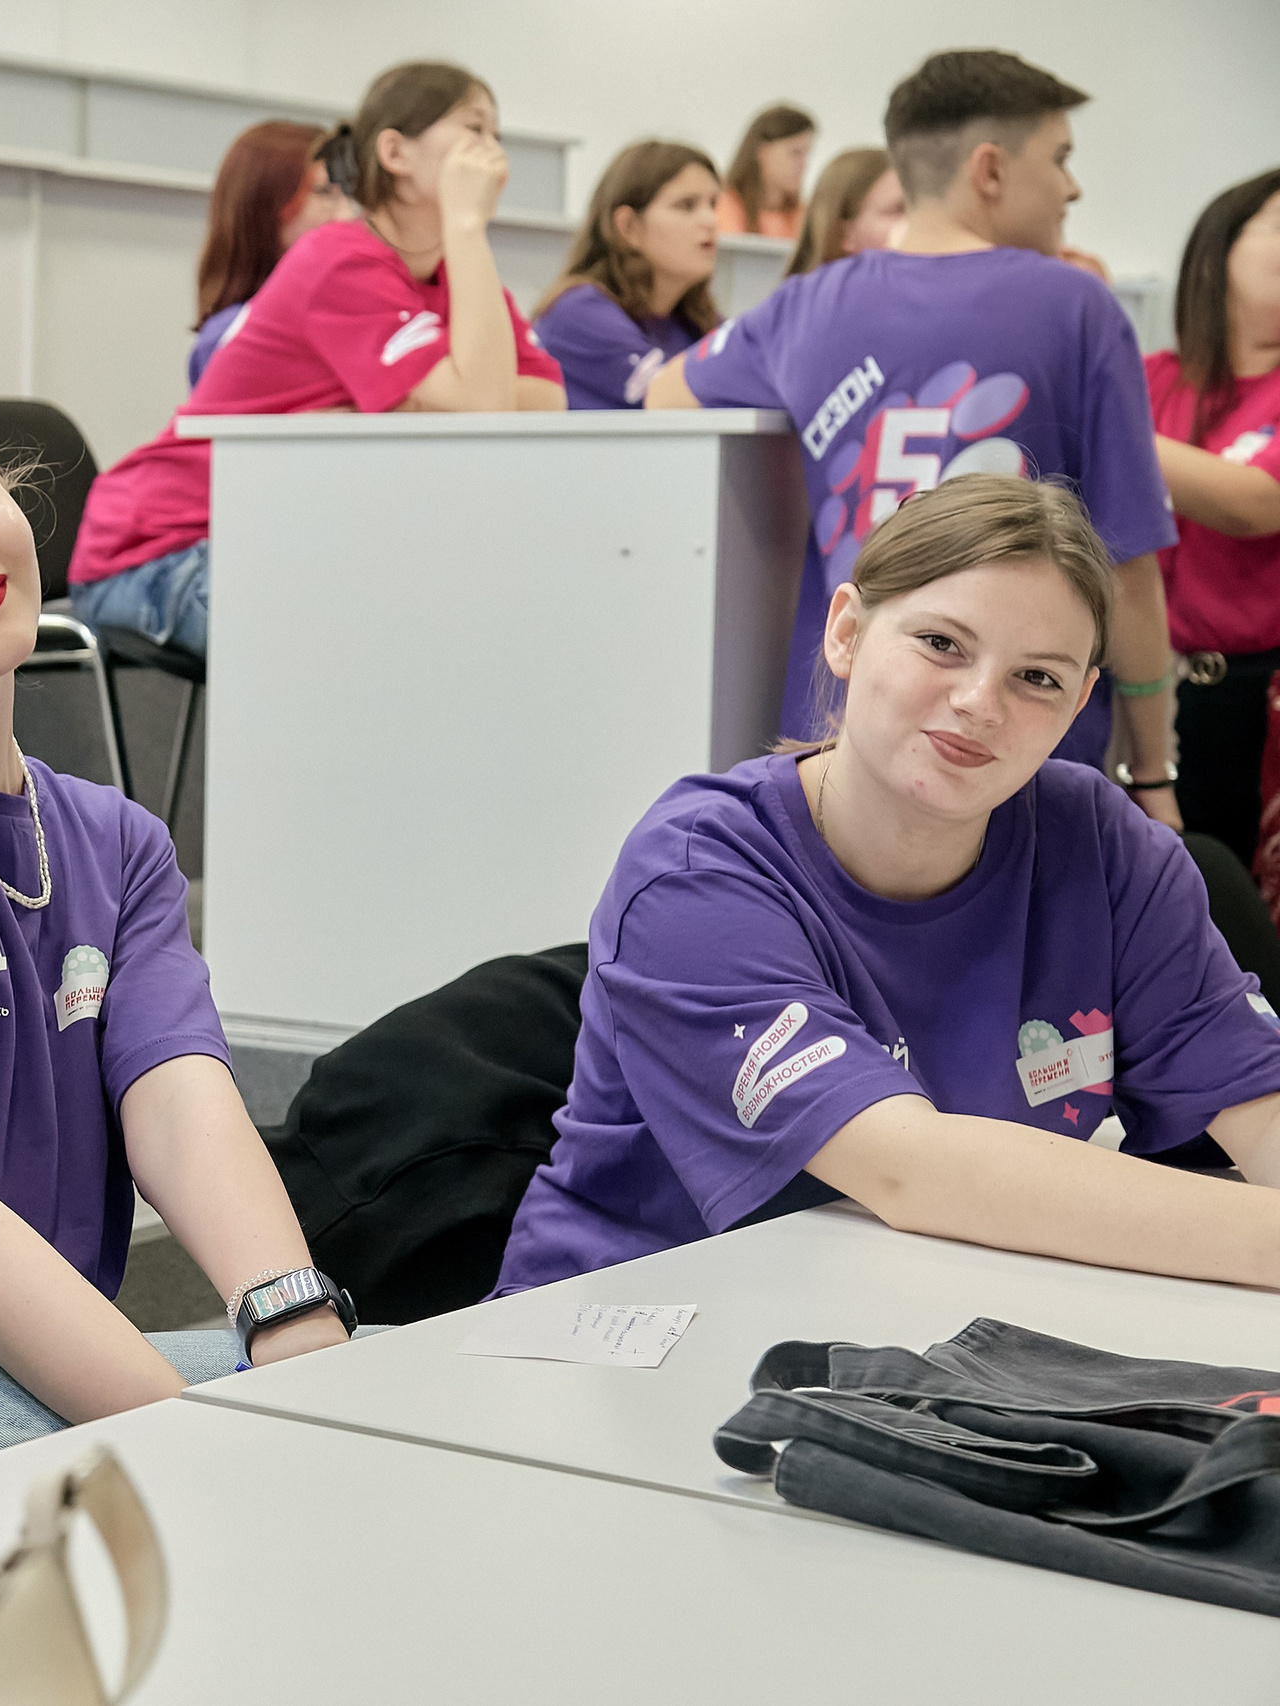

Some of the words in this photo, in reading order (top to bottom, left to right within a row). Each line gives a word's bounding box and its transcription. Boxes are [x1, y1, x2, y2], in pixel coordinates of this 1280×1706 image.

[802, 355, 884, 461] СЕЗОН
[871, 408, 950, 525] 5
[65, 986, 105, 1002] БОЛЬША
[736, 1058, 757, 1101] ВРЕМЯ
[753, 1013, 797, 1061] НОВЫХ
[742, 1044, 832, 1121] ВОЗМОЖНОСТЕЙ!
